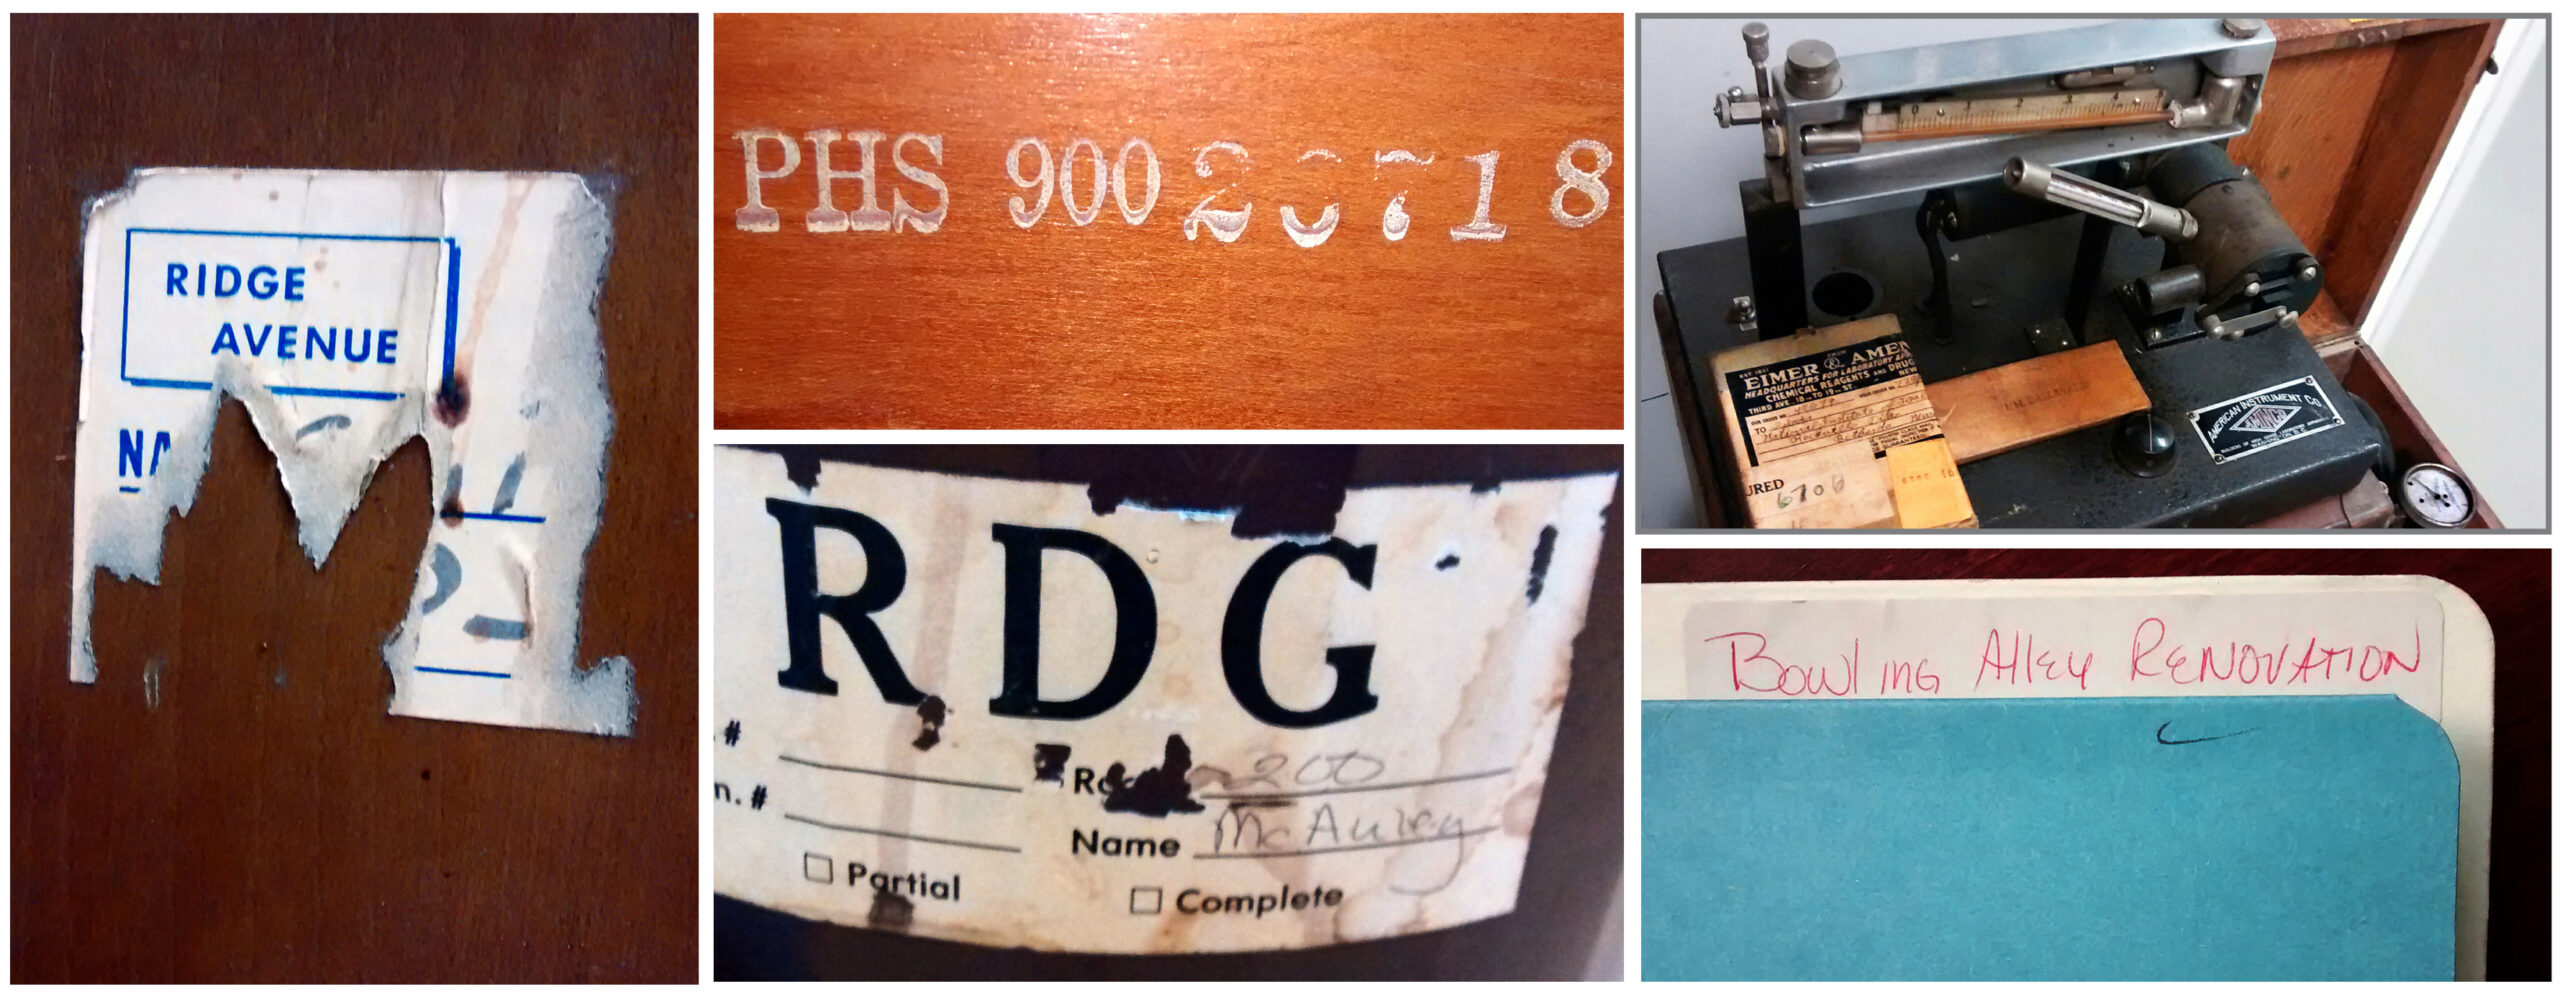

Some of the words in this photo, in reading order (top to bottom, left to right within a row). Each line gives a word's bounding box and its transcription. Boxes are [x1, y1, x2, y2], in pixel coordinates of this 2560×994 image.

[732, 128, 949, 234] PHS
[165, 262, 306, 303] RIDGE
[210, 321, 399, 365] AVENUE
[1743, 363, 1820, 390] EIMER
[1744, 376, 1820, 399] HEADQUARTERS
[1822, 370, 1839, 381] FOR
[1841, 355, 1893, 375] LABORATORY
[1748, 404, 1773, 415] THIRD
[1898, 366, 1918, 376] NEW
[1765, 384, 1818, 403] CHEMICAL
[1820, 371, 1870, 389] REAGENTS
[1754, 426, 1767, 435] TO
[2207, 405, 2241, 443] AMERICAN
[2239, 393, 2302, 410] INSTRUMENT
[2245, 408, 2287, 429] AMINCO
[766, 497, 1379, 729] RDG
[1240, 753, 1385, 790] 200
[1071, 828, 1181, 858] Name
[848, 862, 961, 901] Partial
[1176, 883, 1344, 919] Complete
